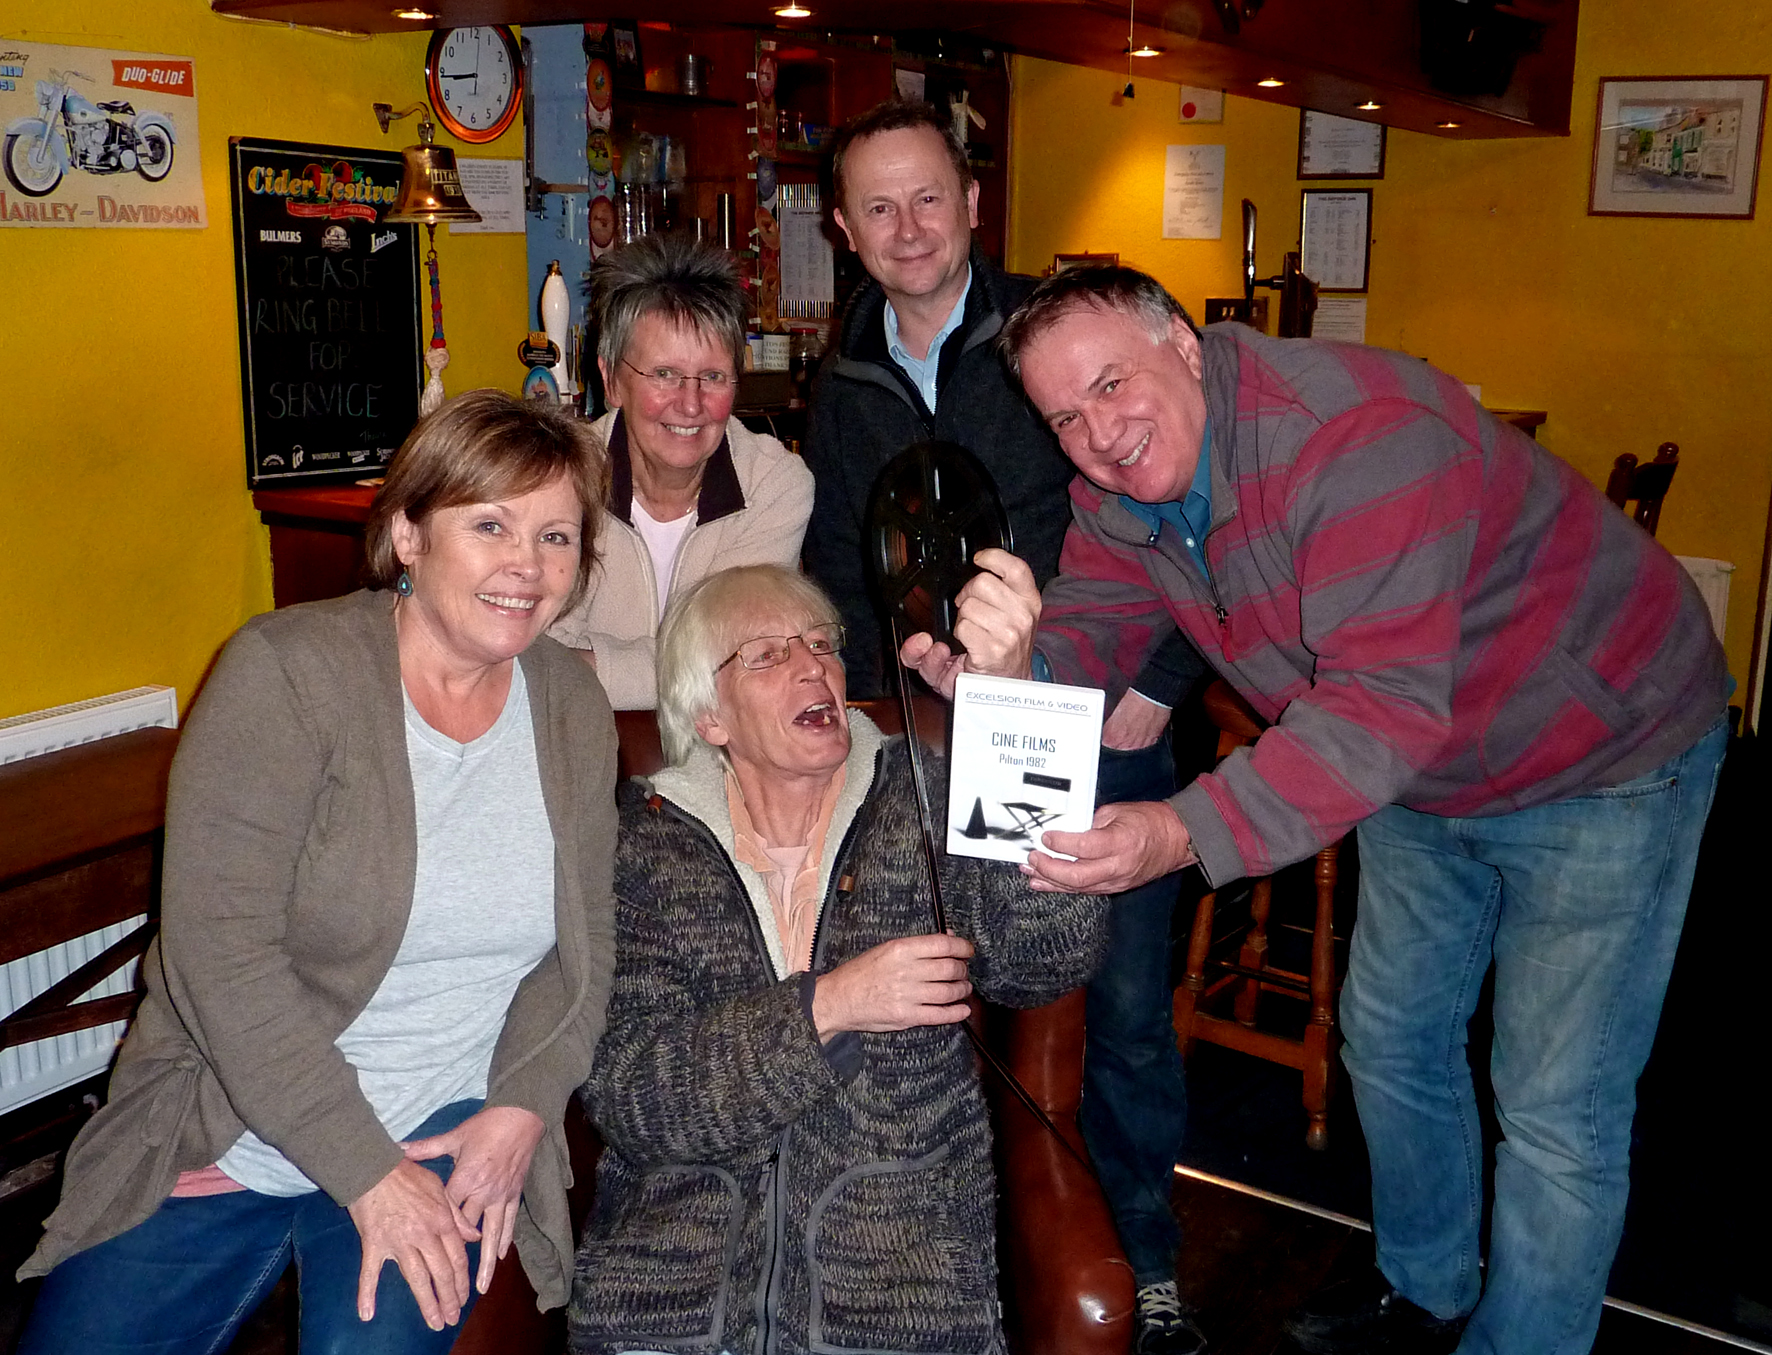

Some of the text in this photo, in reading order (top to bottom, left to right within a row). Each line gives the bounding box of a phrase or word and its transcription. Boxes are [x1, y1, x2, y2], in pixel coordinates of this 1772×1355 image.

[456, 31, 465, 43] 11
[469, 27, 480, 40] 12
[487, 34, 491, 46] 1
[445, 46, 455, 58] 10
[498, 51, 503, 63] 2
[121, 66, 186, 86] DUO-GLIDE
[502, 73, 507, 84] 3
[444, 89, 450, 101] 8
[497, 95, 502, 105] 4
[457, 106, 463, 117] 7
[486, 108, 491, 119] 5
[471, 113, 476, 124] 6
[248, 165, 315, 197] Cider
[260, 229, 302, 244] BULMERS
[277, 255, 378, 290] PLEASE
[255, 298, 392, 335] RING BELL
[267, 381, 383, 419] SERVICE
[966, 691, 1022, 705] EXCELSIOR
[1024, 697, 1045, 708] FILM
[1057, 701, 1088, 713] VIDEO
[991, 731, 1057, 753] CINE FILMS
[999, 753, 1047, 769] Pilton 1982
